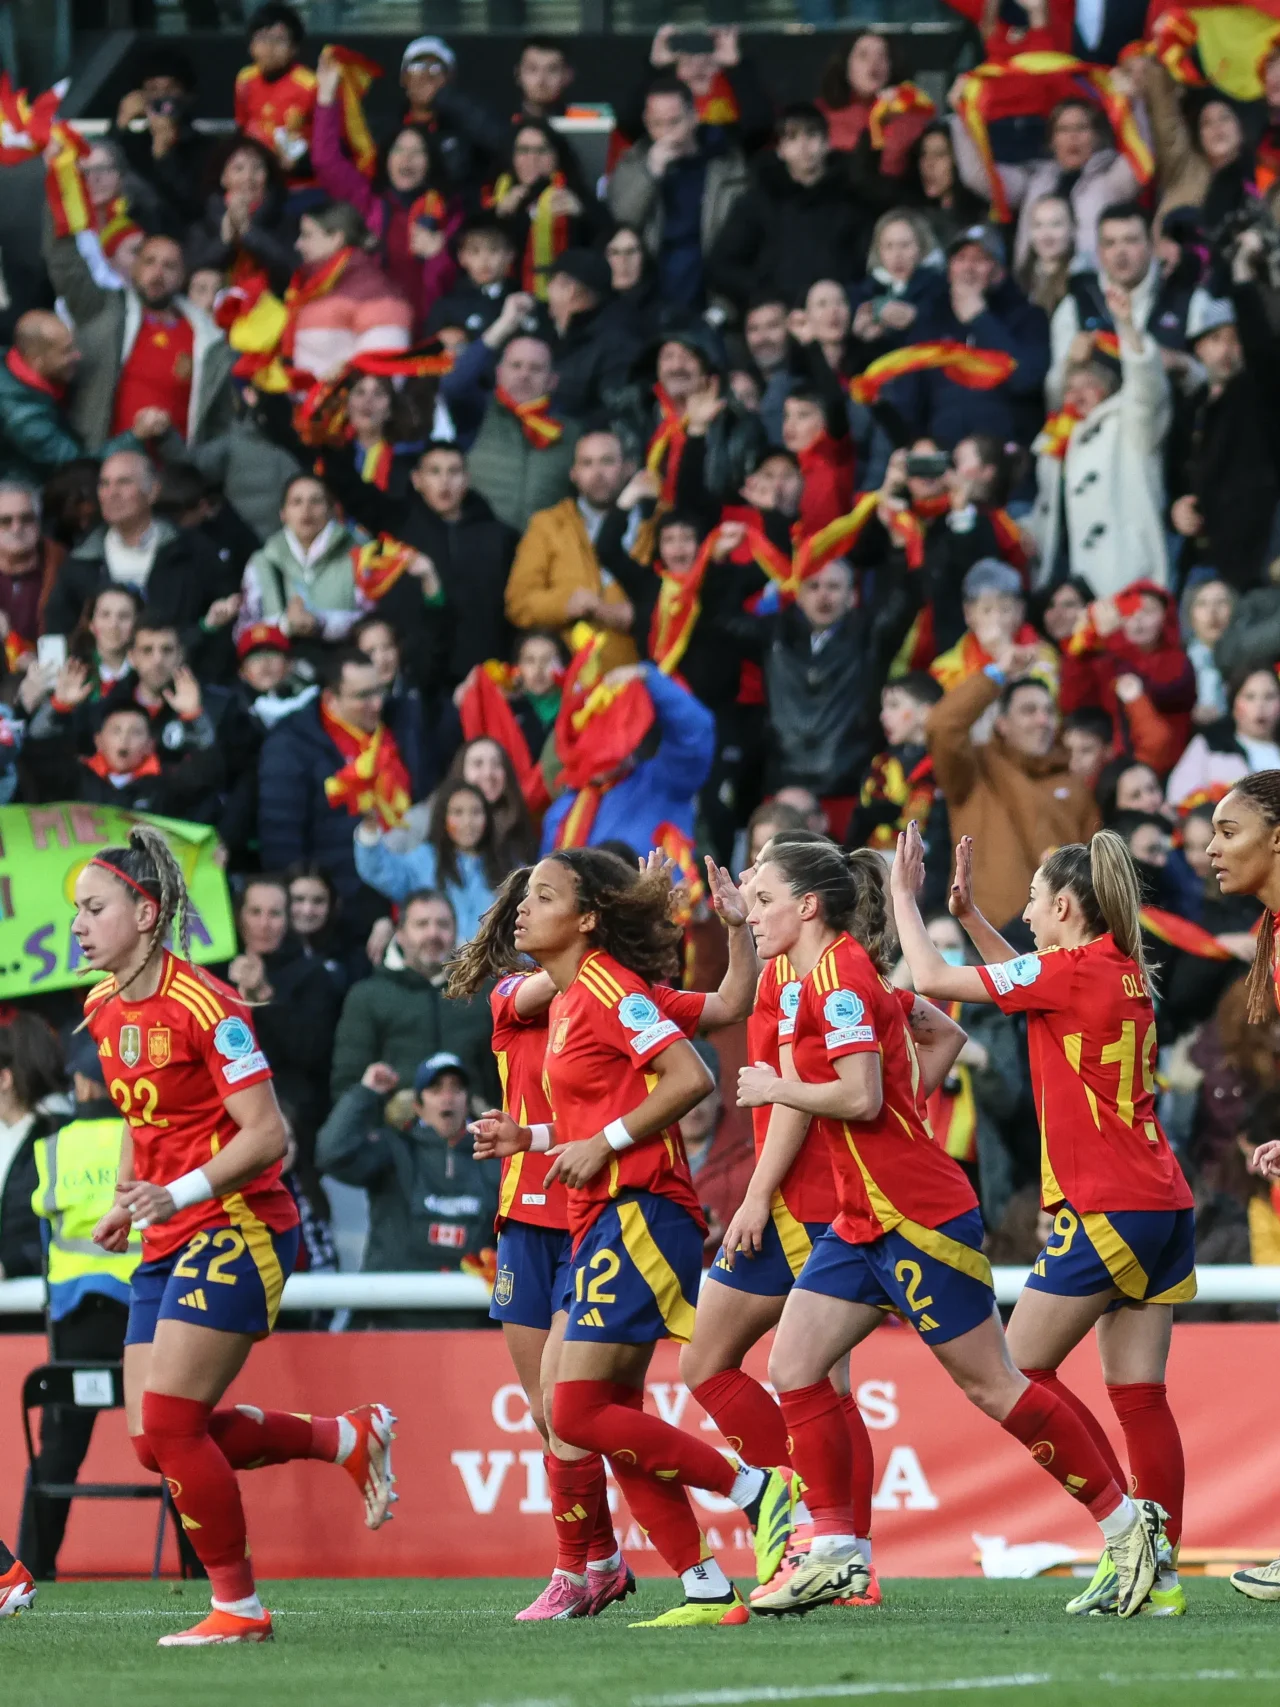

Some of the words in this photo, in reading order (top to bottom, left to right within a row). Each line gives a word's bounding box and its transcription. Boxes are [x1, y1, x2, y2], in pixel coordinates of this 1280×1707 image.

[110, 1077, 169, 1128] 22
[63, 1168, 119, 1190] GAR
[173, 1228, 246, 1286] 22
[575, 1248, 621, 1304] 12
[894, 1259, 934, 1313] 2
